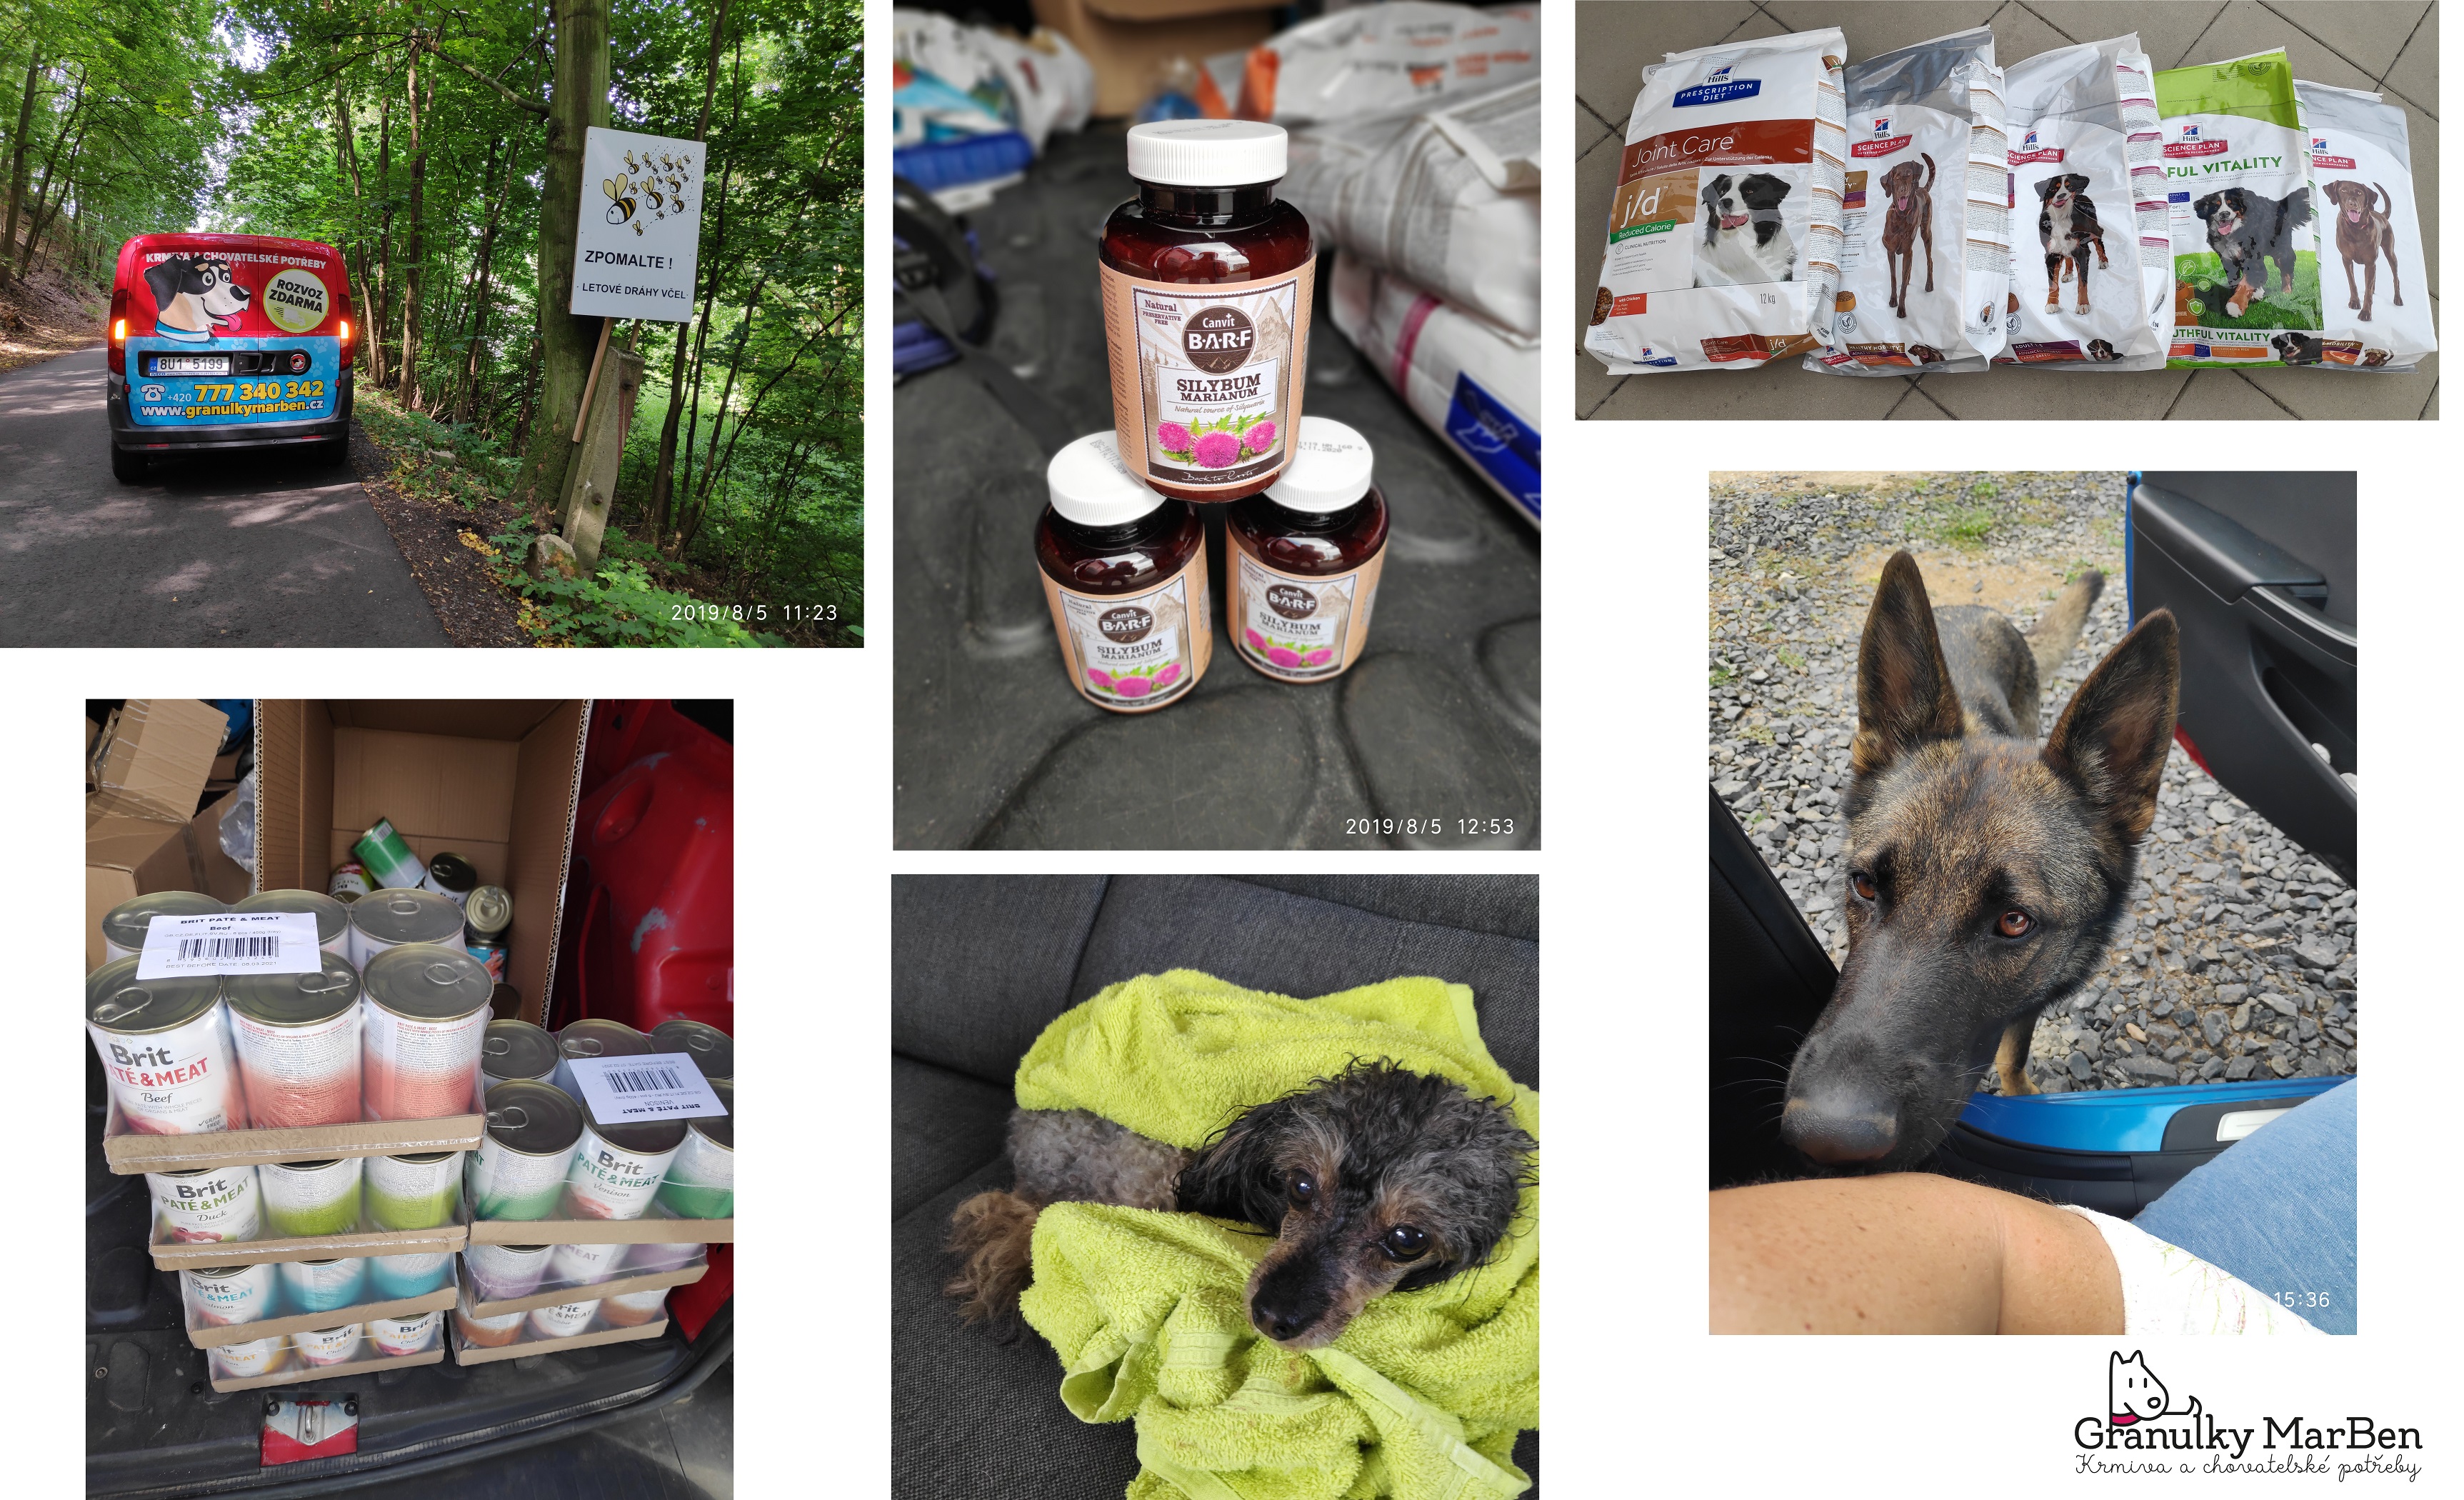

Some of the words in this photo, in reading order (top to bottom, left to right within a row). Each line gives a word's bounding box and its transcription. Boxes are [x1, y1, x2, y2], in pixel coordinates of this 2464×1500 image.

[1708, 74, 1729, 84] Hill's
[1681, 83, 1753, 99] PRESCRIPTION
[1874, 131, 1890, 139] Hill's
[1632, 141, 1677, 167] Joint
[1682, 136, 1733, 155] Care
[1857, 141, 1888, 151] SCIENCE
[1889, 138, 1907, 148] PLAN
[2167, 166, 2198, 178] FUL
[2202, 156, 2283, 174] VITALITY
[1619, 227, 1644, 239] Reduced
[1645, 223, 1671, 233] Calorie
[203, 251, 279, 264] CHOVATELSKÉ
[281, 256, 327, 269] POTŘEBY
[584, 250, 664, 269] ZPOMALTE
[276, 279, 324, 299] ROZVOZ
[582, 283, 621, 294] LETOVÉ
[624, 285, 659, 296] DRÁHY
[661, 287, 686, 299] VČEL
[269, 289, 323, 313] ZDARMA
[1144, 299, 1177, 312] Natural
[1760, 293, 1767, 304] 12
[1768, 293, 1776, 304] kg
[1143, 311, 1181, 322] PRESERVATIVE
[1203, 313, 1235, 329] Canvit
[2173, 329, 2213, 339] UTHFUL
[2216, 331, 2270, 341] VITALITY
[160, 359, 182, 370] 8U1
[193, 358, 223, 370] 5199
[1176, 373, 1261, 392] SILYBUM
[167, 393, 192, 402] +420
[194, 384, 235, 402] 777
[239, 382, 281, 401] 340
[285, 380, 324, 399] 342
[1181, 387, 1258, 402] MARIANUM
[140, 399, 324, 419] www.granulkymarben.cz
[1174, 405, 1203, 414] Natural
[1203, 405, 1225, 414] source
[1226, 404, 1235, 414] of
[1234, 399, 1265, 411] Silymarin
[1279, 587, 1303, 599] Canvit
[1068, 599, 1092, 609] Natural
[1111, 609, 1137, 619] Canvit
[1259, 611, 1321, 630] SILYBUM
[1261, 619, 1318, 636] MARIANUM
[1097, 638, 1163, 654] SILYBUM
[1101, 647, 1161, 660] MARIANUM
[109, 1043, 174, 1067] Brit
[141, 1092, 174, 1104] Beef
[204, 1114, 221, 1124] GRAIN
[598, 1150, 643, 1175] Brit
[176, 1179, 228, 1199] Brit
[594, 1181, 631, 1197] Venison
[196, 1210, 228, 1221] Duck
[190, 1276, 230, 1293] Brit
[400, 1319, 430, 1333] Brit
[322, 1326, 354, 1344] Brit
